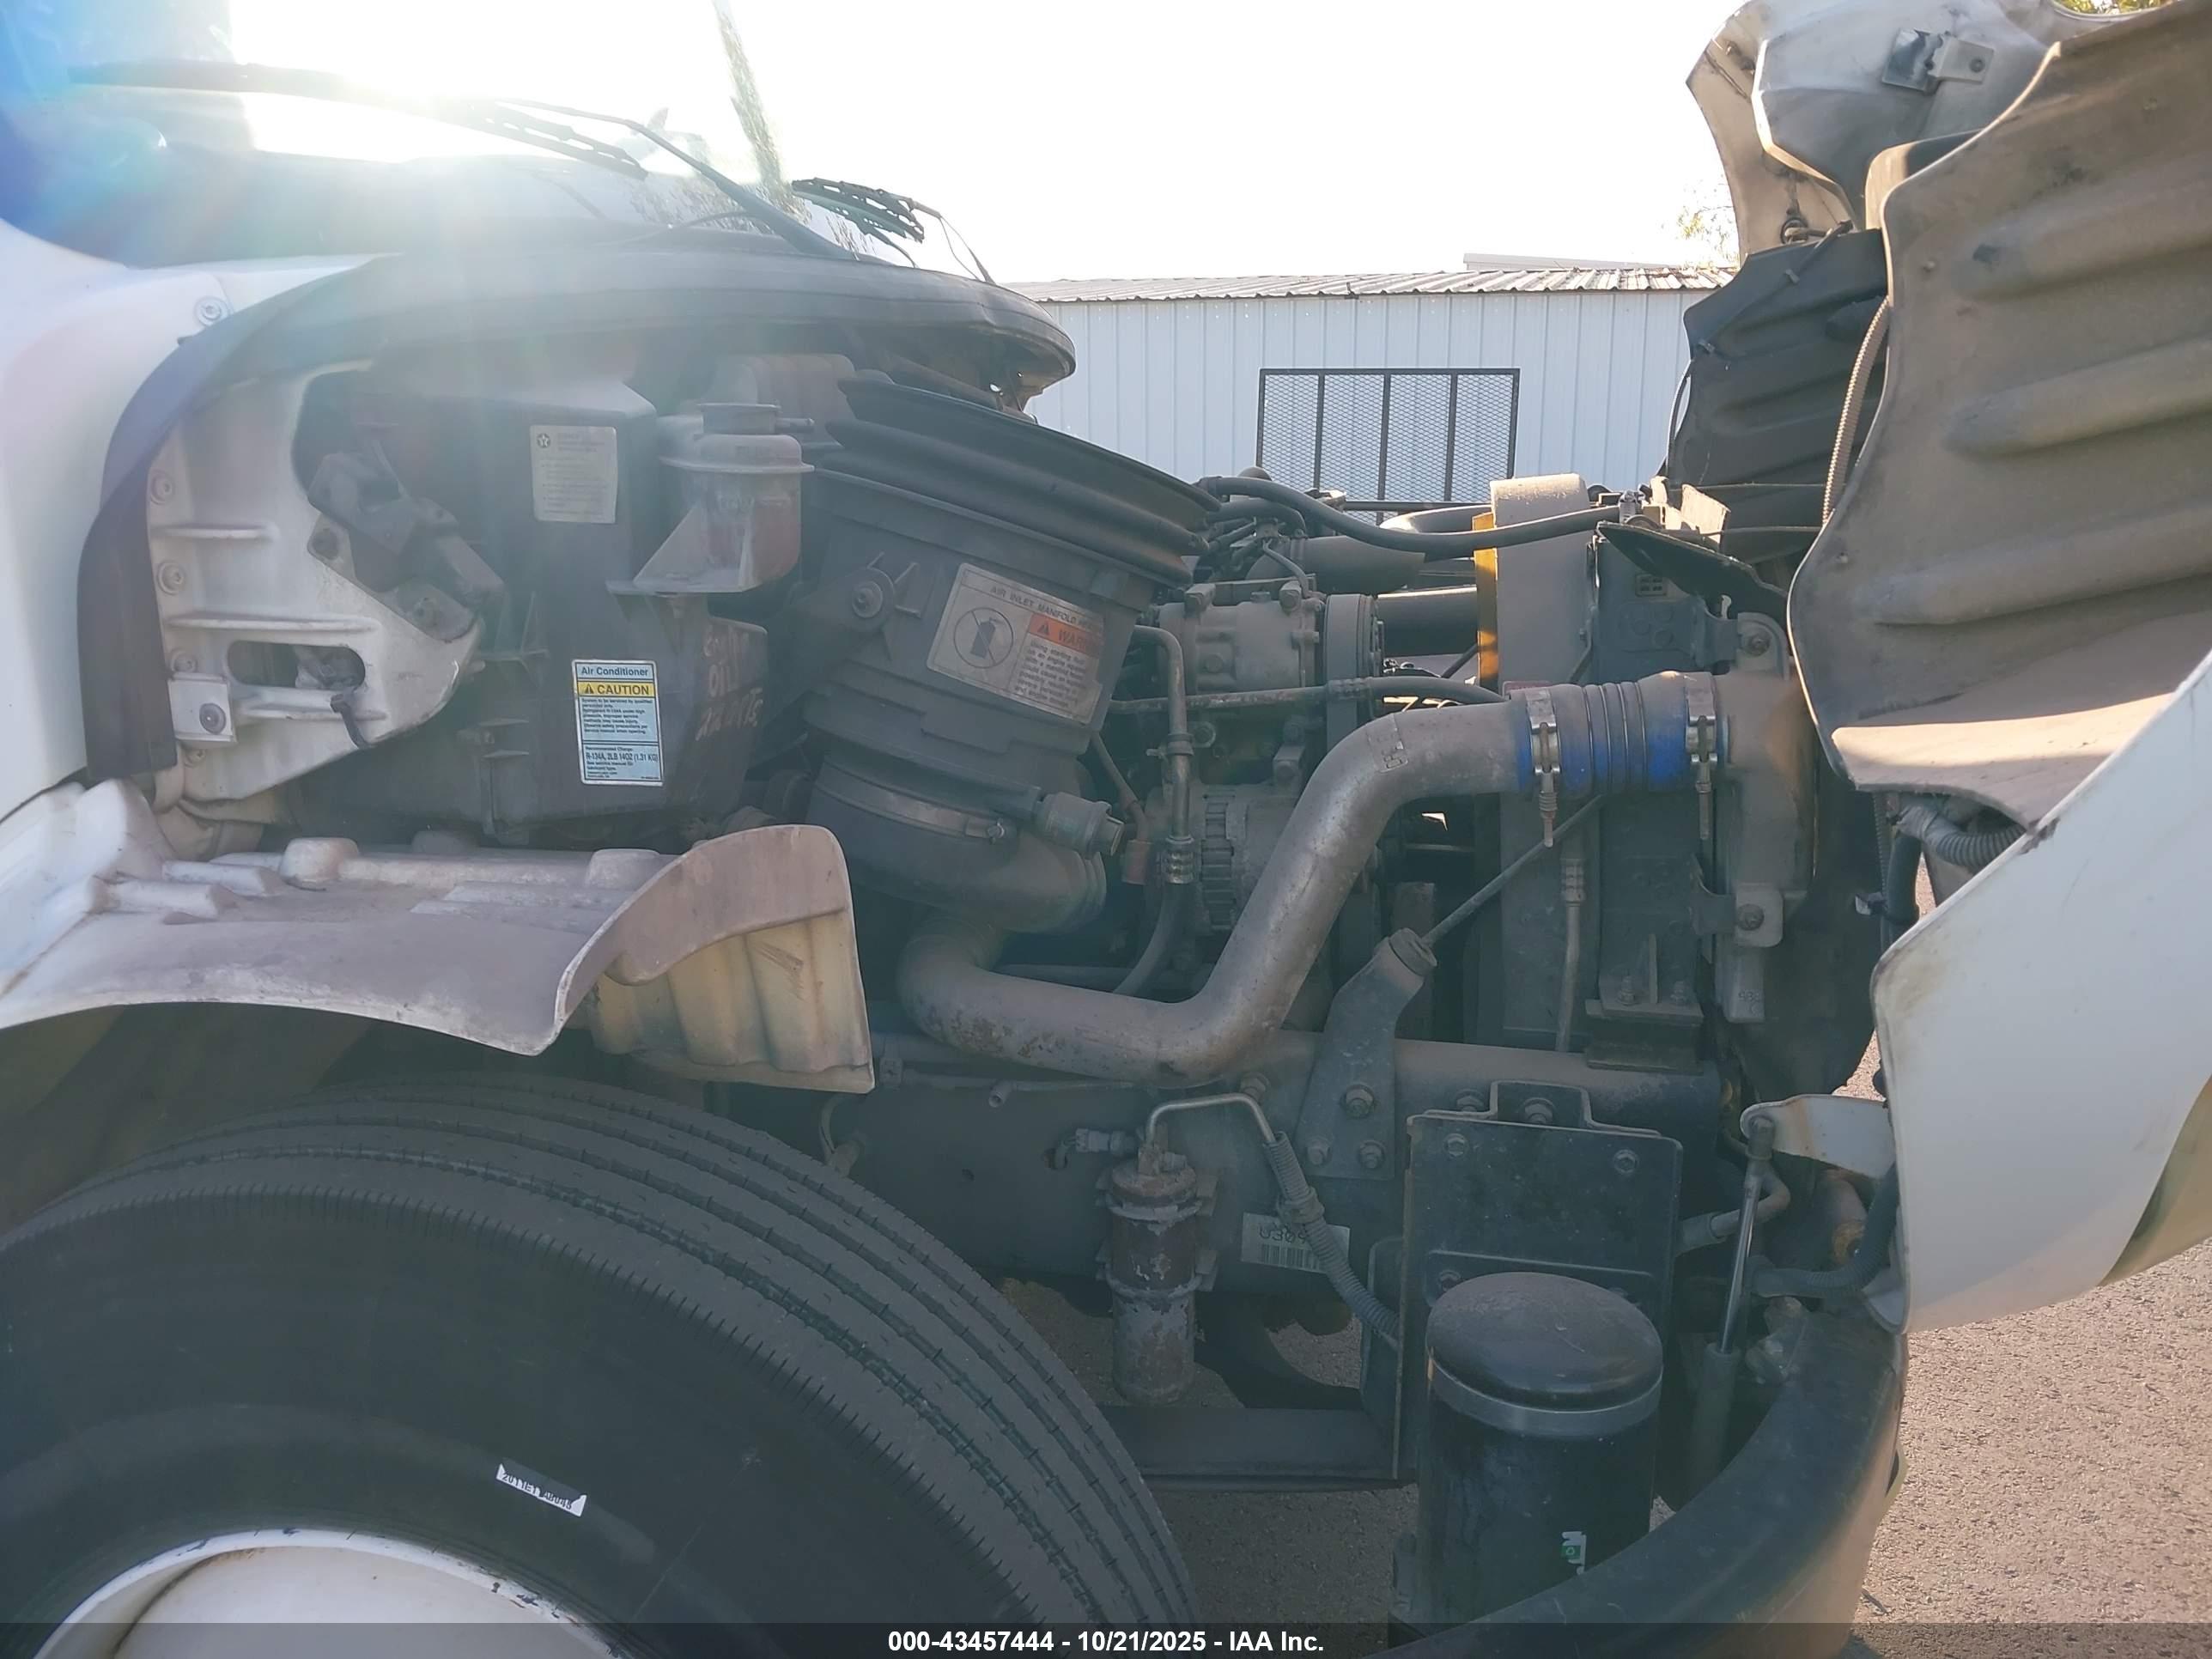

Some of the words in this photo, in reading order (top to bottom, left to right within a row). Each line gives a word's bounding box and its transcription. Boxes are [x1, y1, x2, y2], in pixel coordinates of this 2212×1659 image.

[1037, 604, 1077, 623] MANIFOLD
[581, 666, 593, 675] Air
[596, 666, 648, 676] Conditioner
[597, 684, 649, 695] CAUTION
